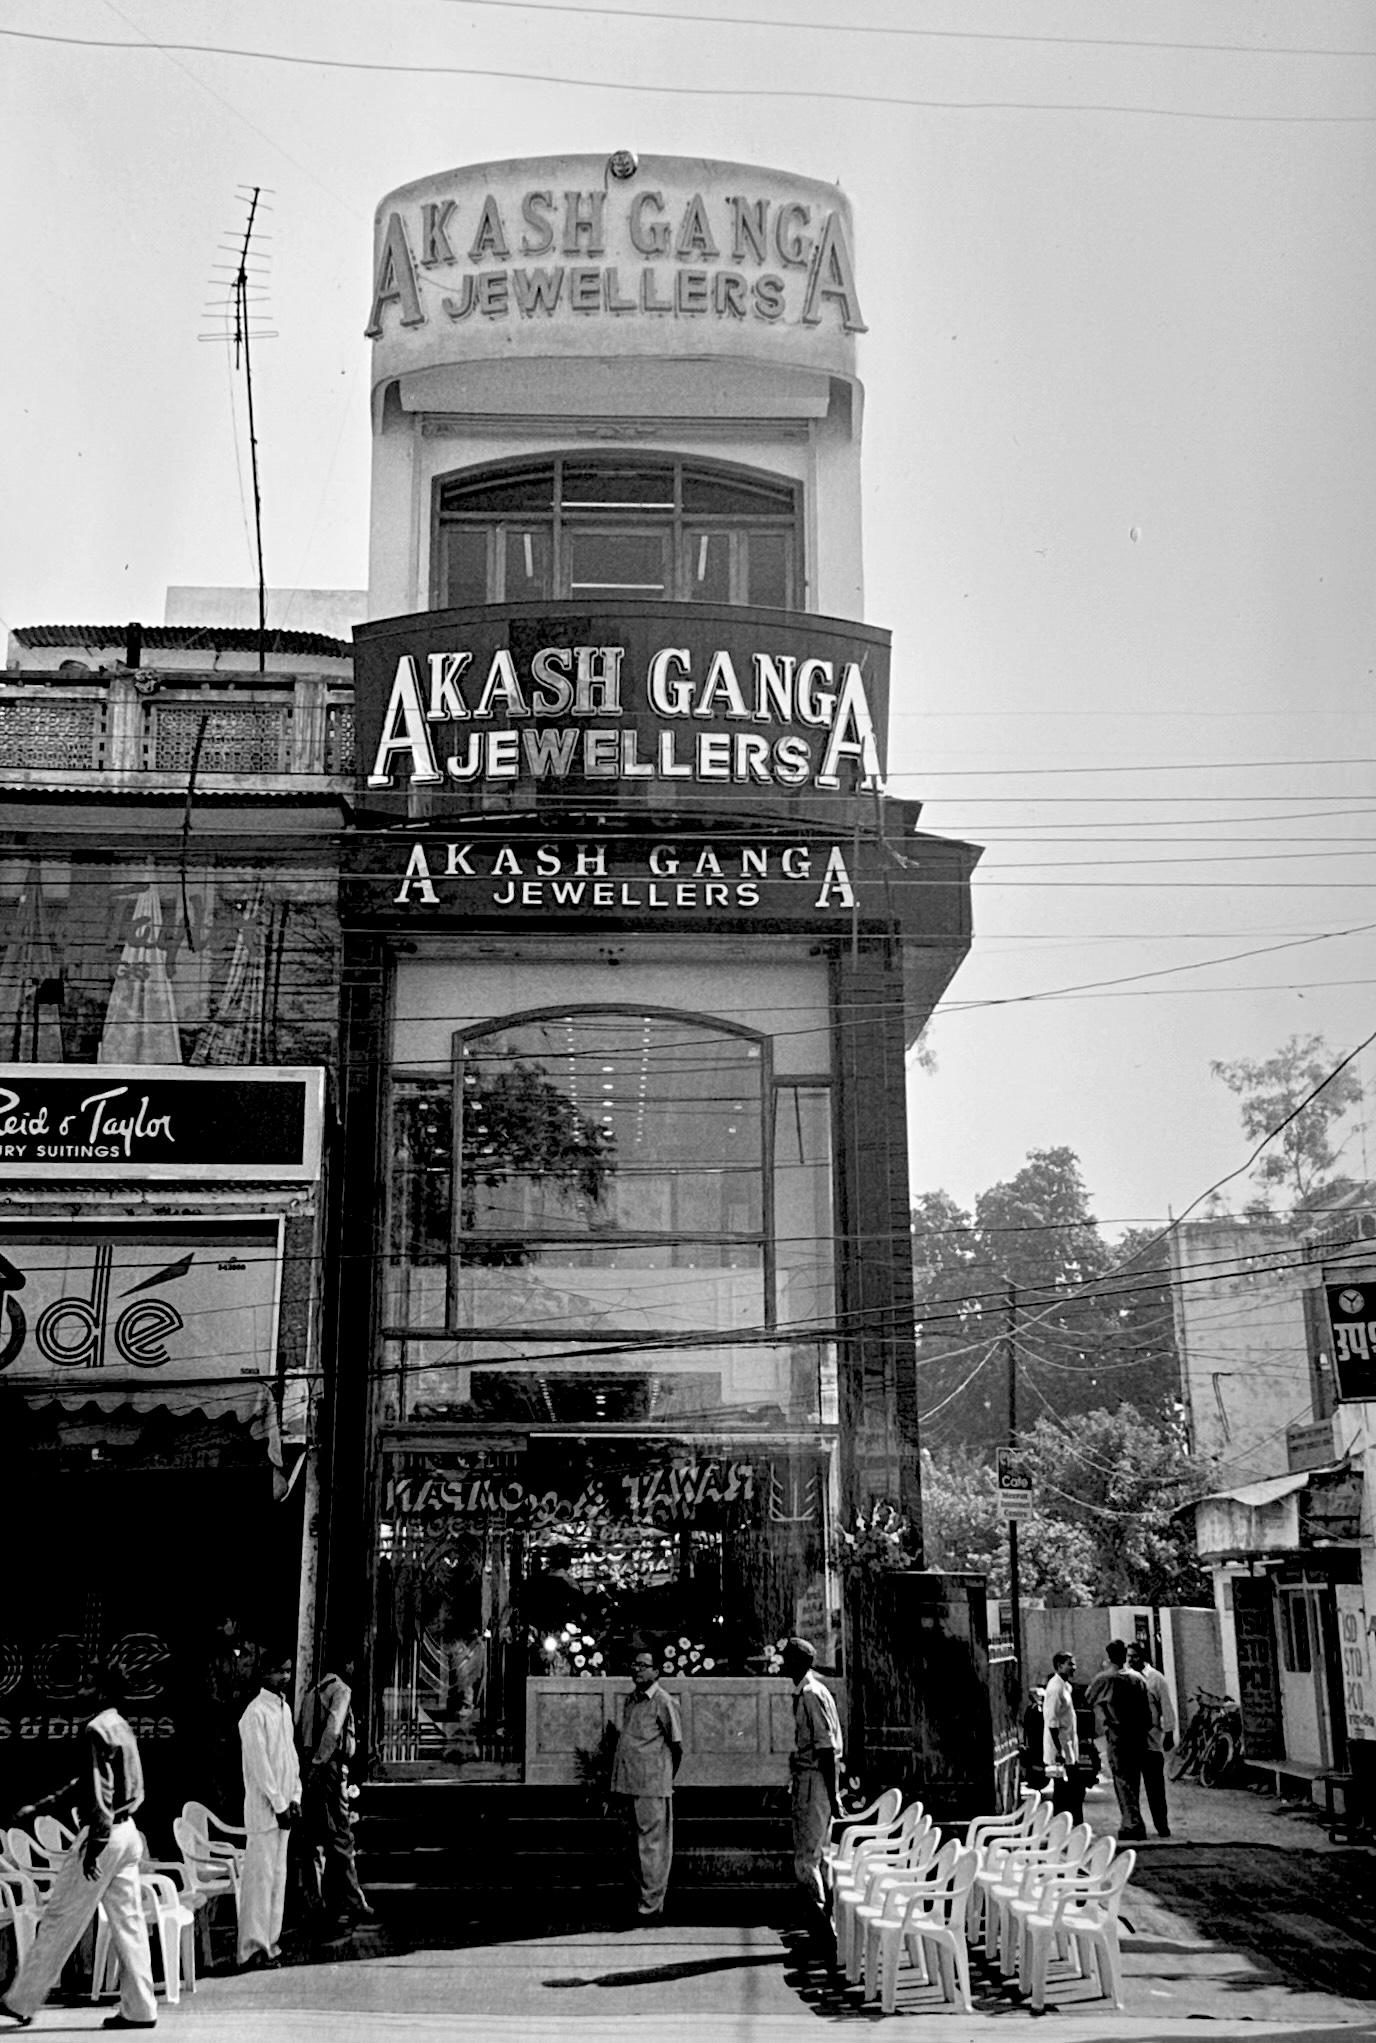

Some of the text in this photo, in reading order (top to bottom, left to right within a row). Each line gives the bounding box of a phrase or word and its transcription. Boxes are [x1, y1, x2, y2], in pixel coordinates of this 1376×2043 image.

[364, 190, 868, 339] AKASH GANGA
[441, 266, 787, 321] JEWELLERS
[367, 646, 886, 795] AKASH GANGA
[446, 728, 812, 786] JEWELLERS
[394, 843, 859, 909] AKASH GANGA
[493, 880, 761, 907] JEWELLERS
[0, 1144, 120, 1158] RY SUITINGS
[81, 1085, 176, 1158] Taylor
